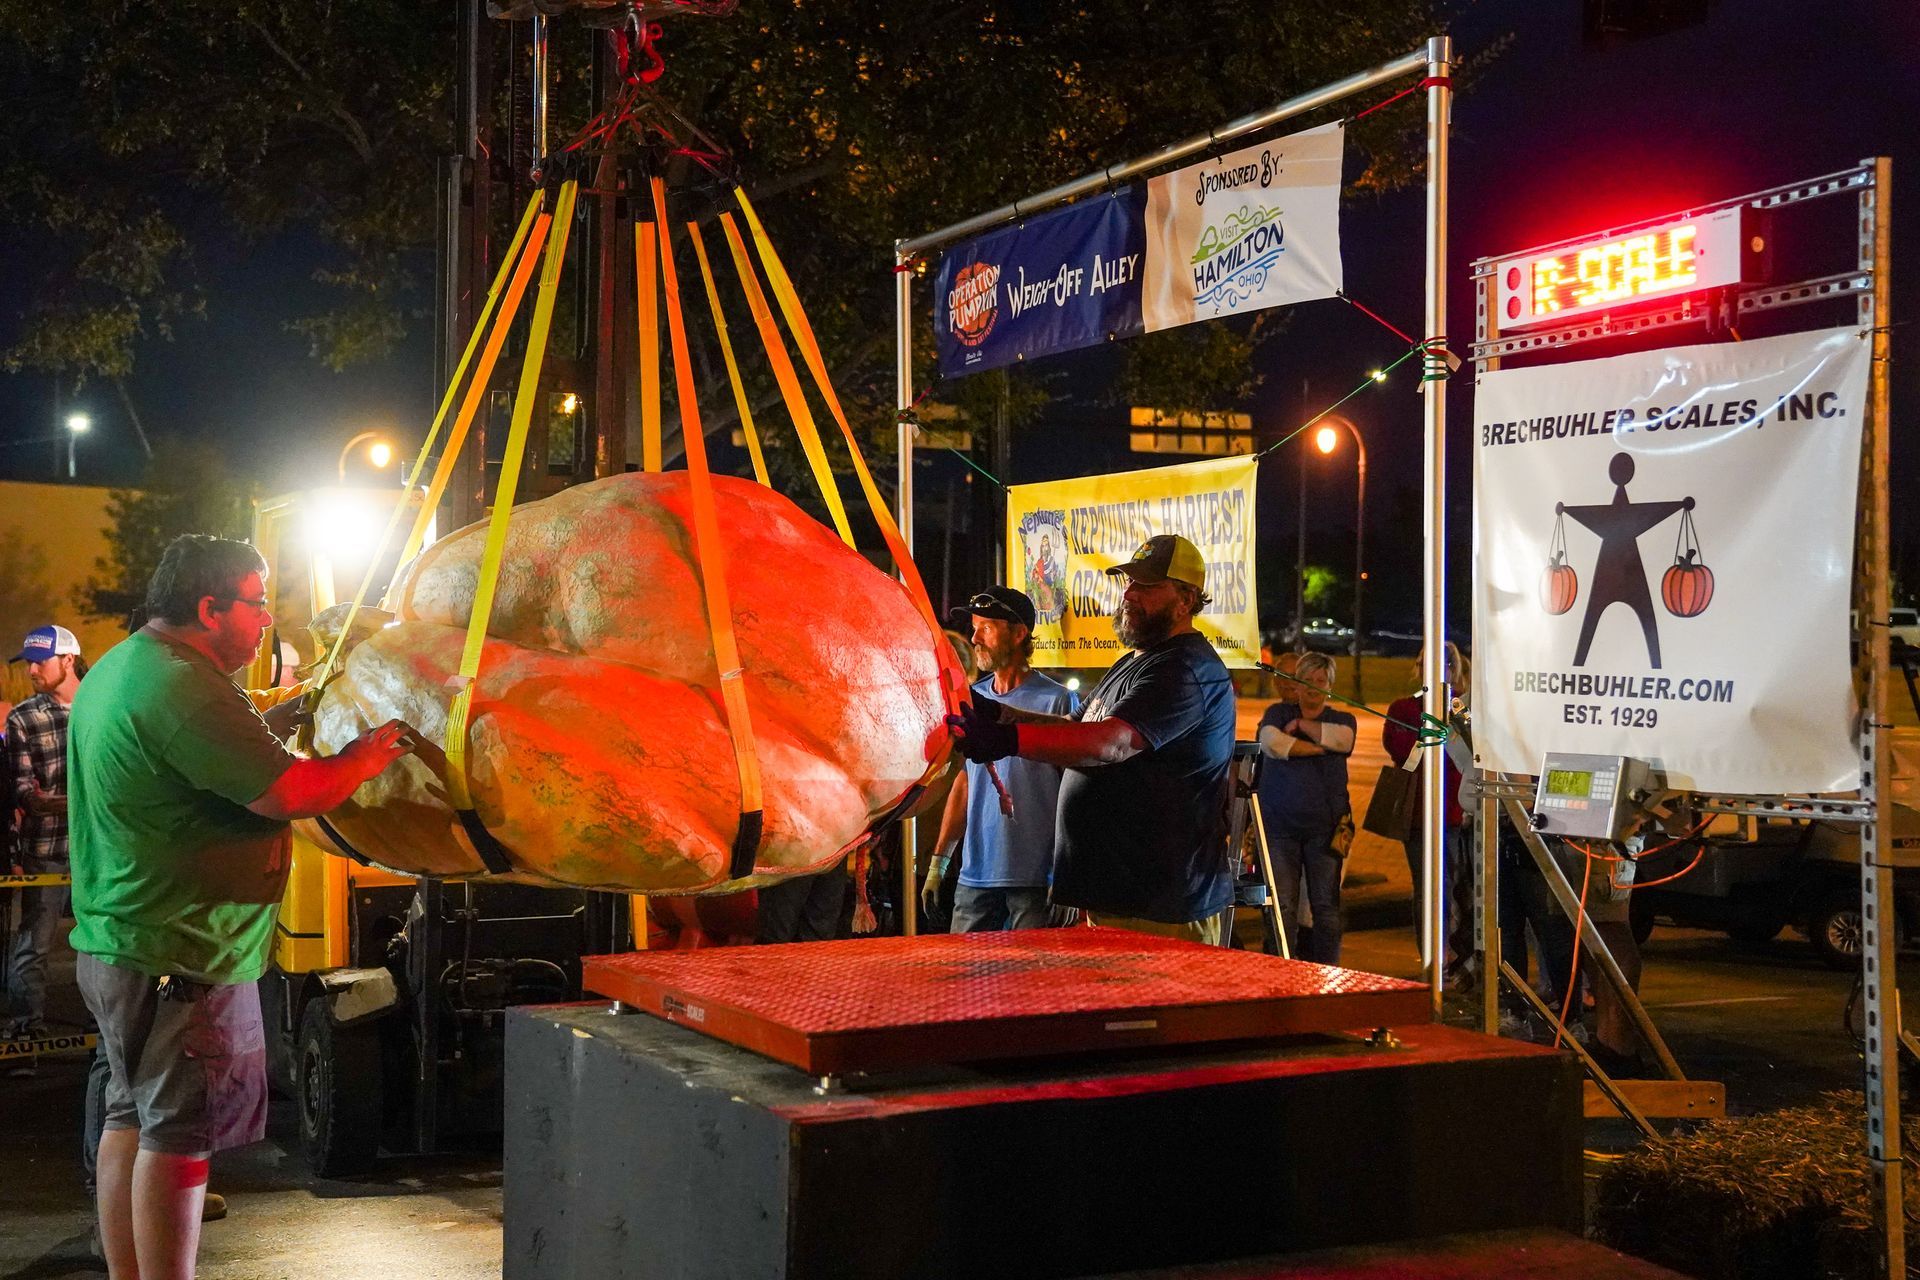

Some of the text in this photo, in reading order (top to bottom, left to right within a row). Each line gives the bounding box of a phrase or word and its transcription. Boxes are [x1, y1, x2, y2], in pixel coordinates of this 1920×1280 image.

[1196, 164, 1258, 206] SPONSORED
[1220, 223, 1239, 240] VISIT
[1090, 253, 1139, 296] ALLEY
[1194, 220, 1284, 292] HAMILTON
[948, 265, 1000, 309] OPERATION
[1238, 272, 1262, 288] OHIO
[949, 284, 998, 333] PUMPKIN
[1482, 391, 1846, 447] BRECHBUHLER SCALES, INC.
[1071, 488, 1245, 555] NEPTUNE'S HARVEST
[1072, 569, 1126, 618] ORGAN
[1031, 637, 1056, 650] oducts
[1058, 637, 1076, 650] From
[1079, 637, 1092, 650] The
[1094, 637, 1120, 651] Ocean,
[1216, 635, 1246, 650] Motion
[1514, 671, 1734, 703] BRECHBUHLER.COM
[1564, 704, 1658, 729] EST. 1929
